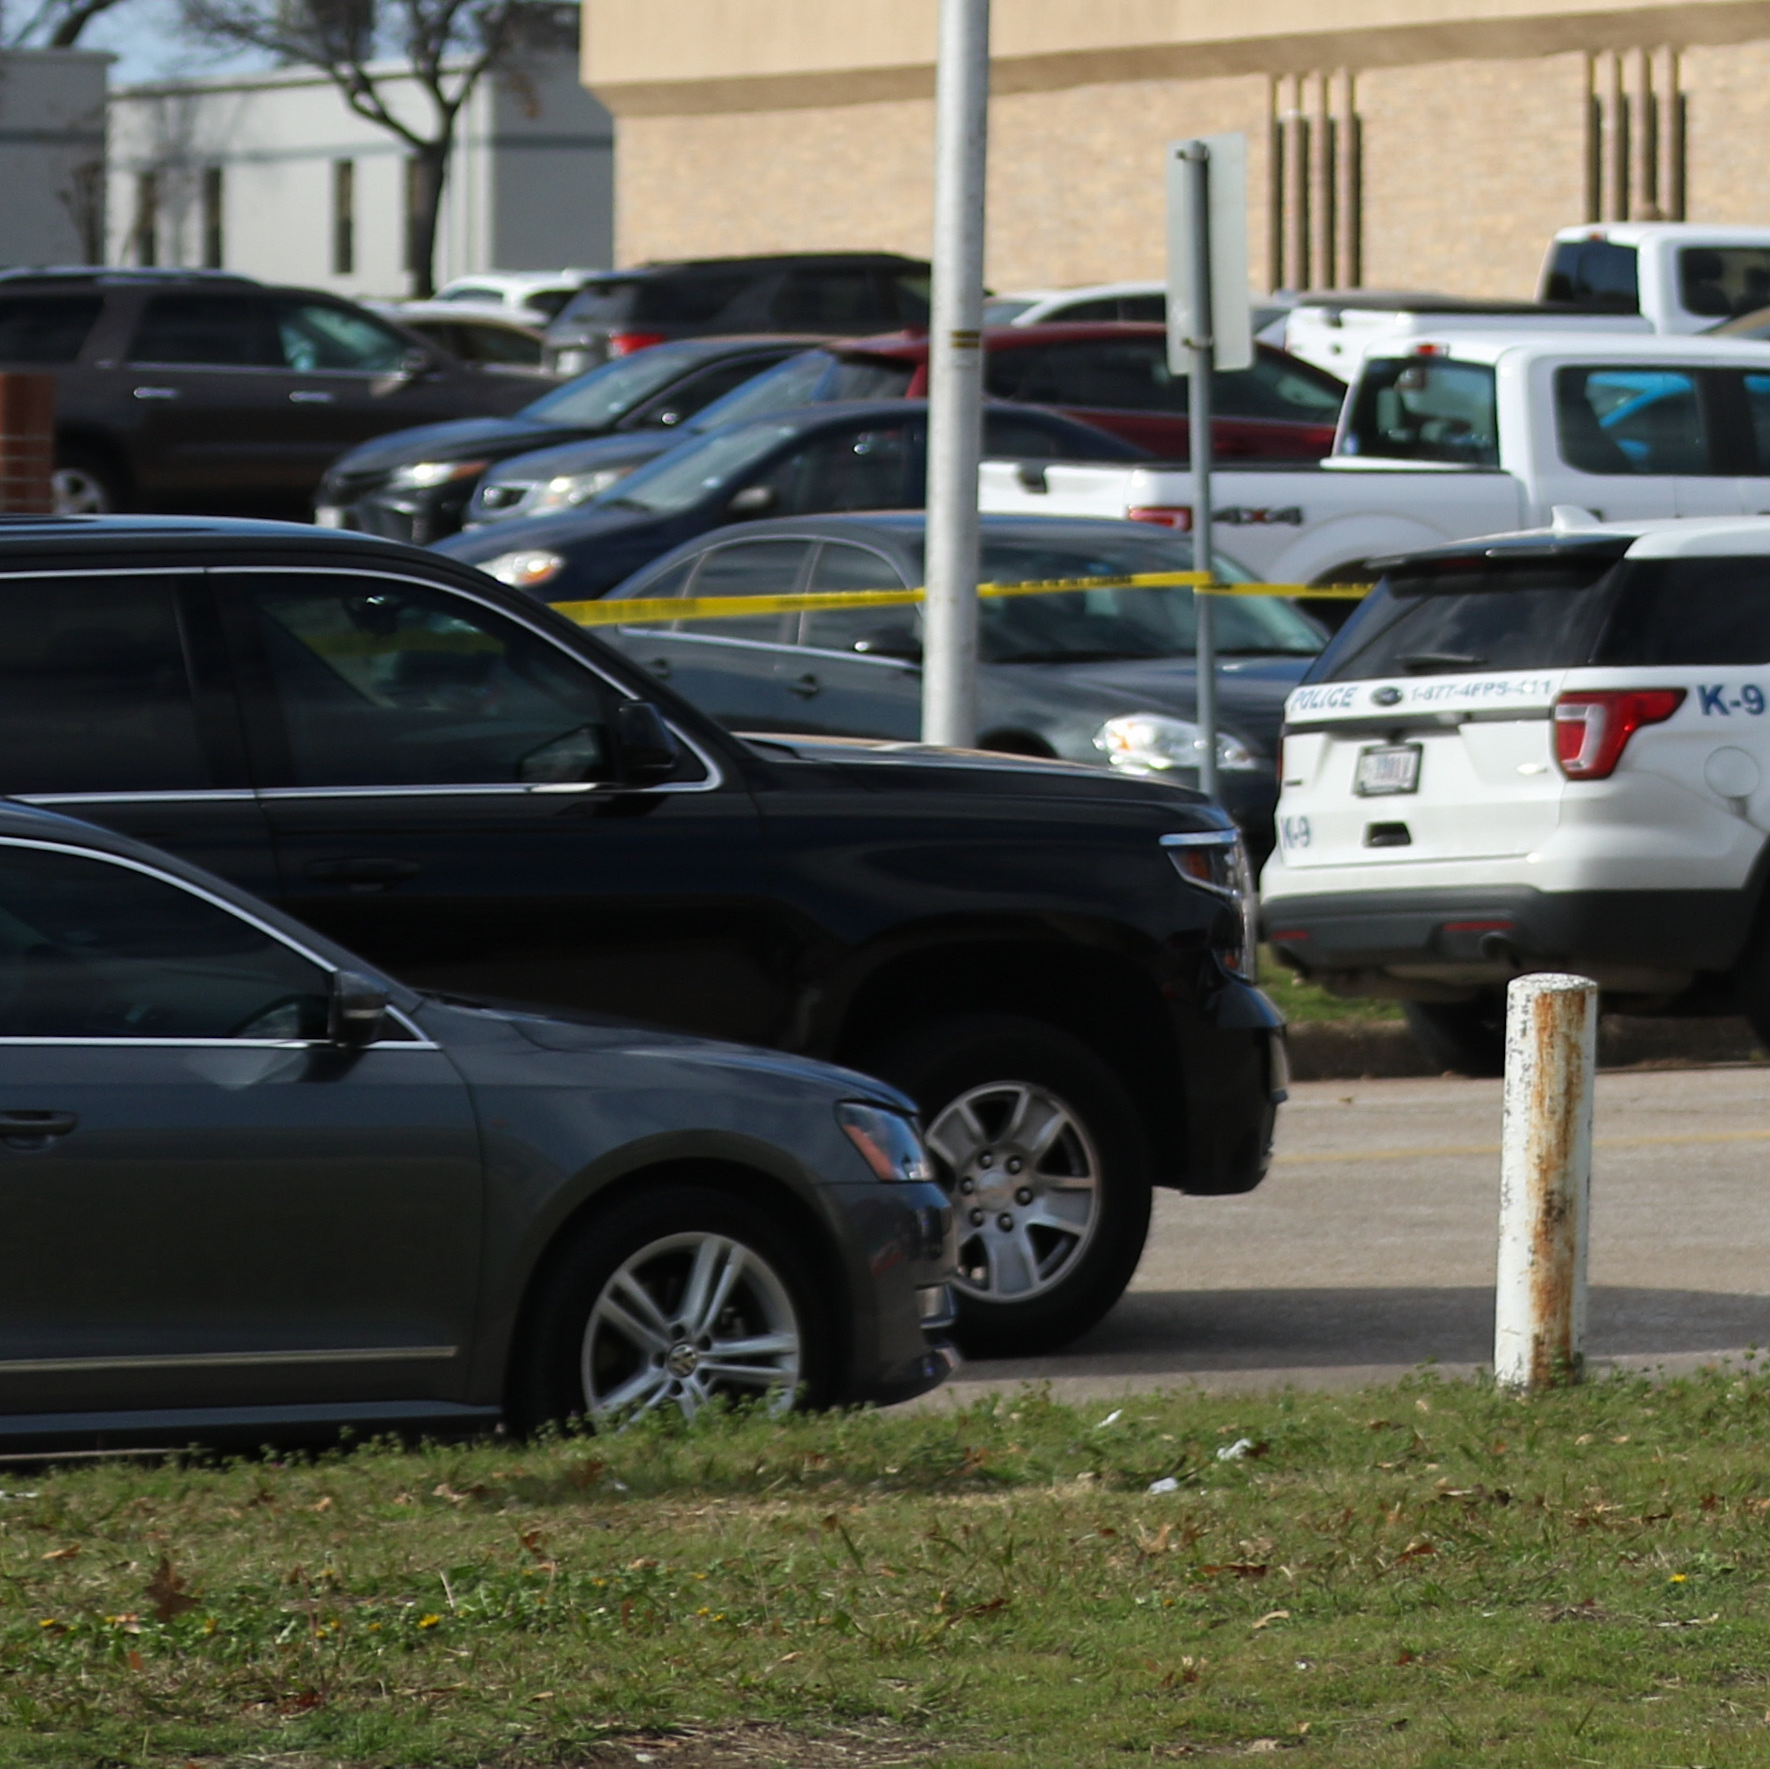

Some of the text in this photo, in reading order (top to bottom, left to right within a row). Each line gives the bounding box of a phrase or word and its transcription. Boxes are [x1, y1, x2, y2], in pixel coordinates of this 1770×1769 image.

[1290, 686, 1358, 711] POLICE
[1697, 684, 1766, 716] K-9
[1280, 816, 1311, 849] K-9
